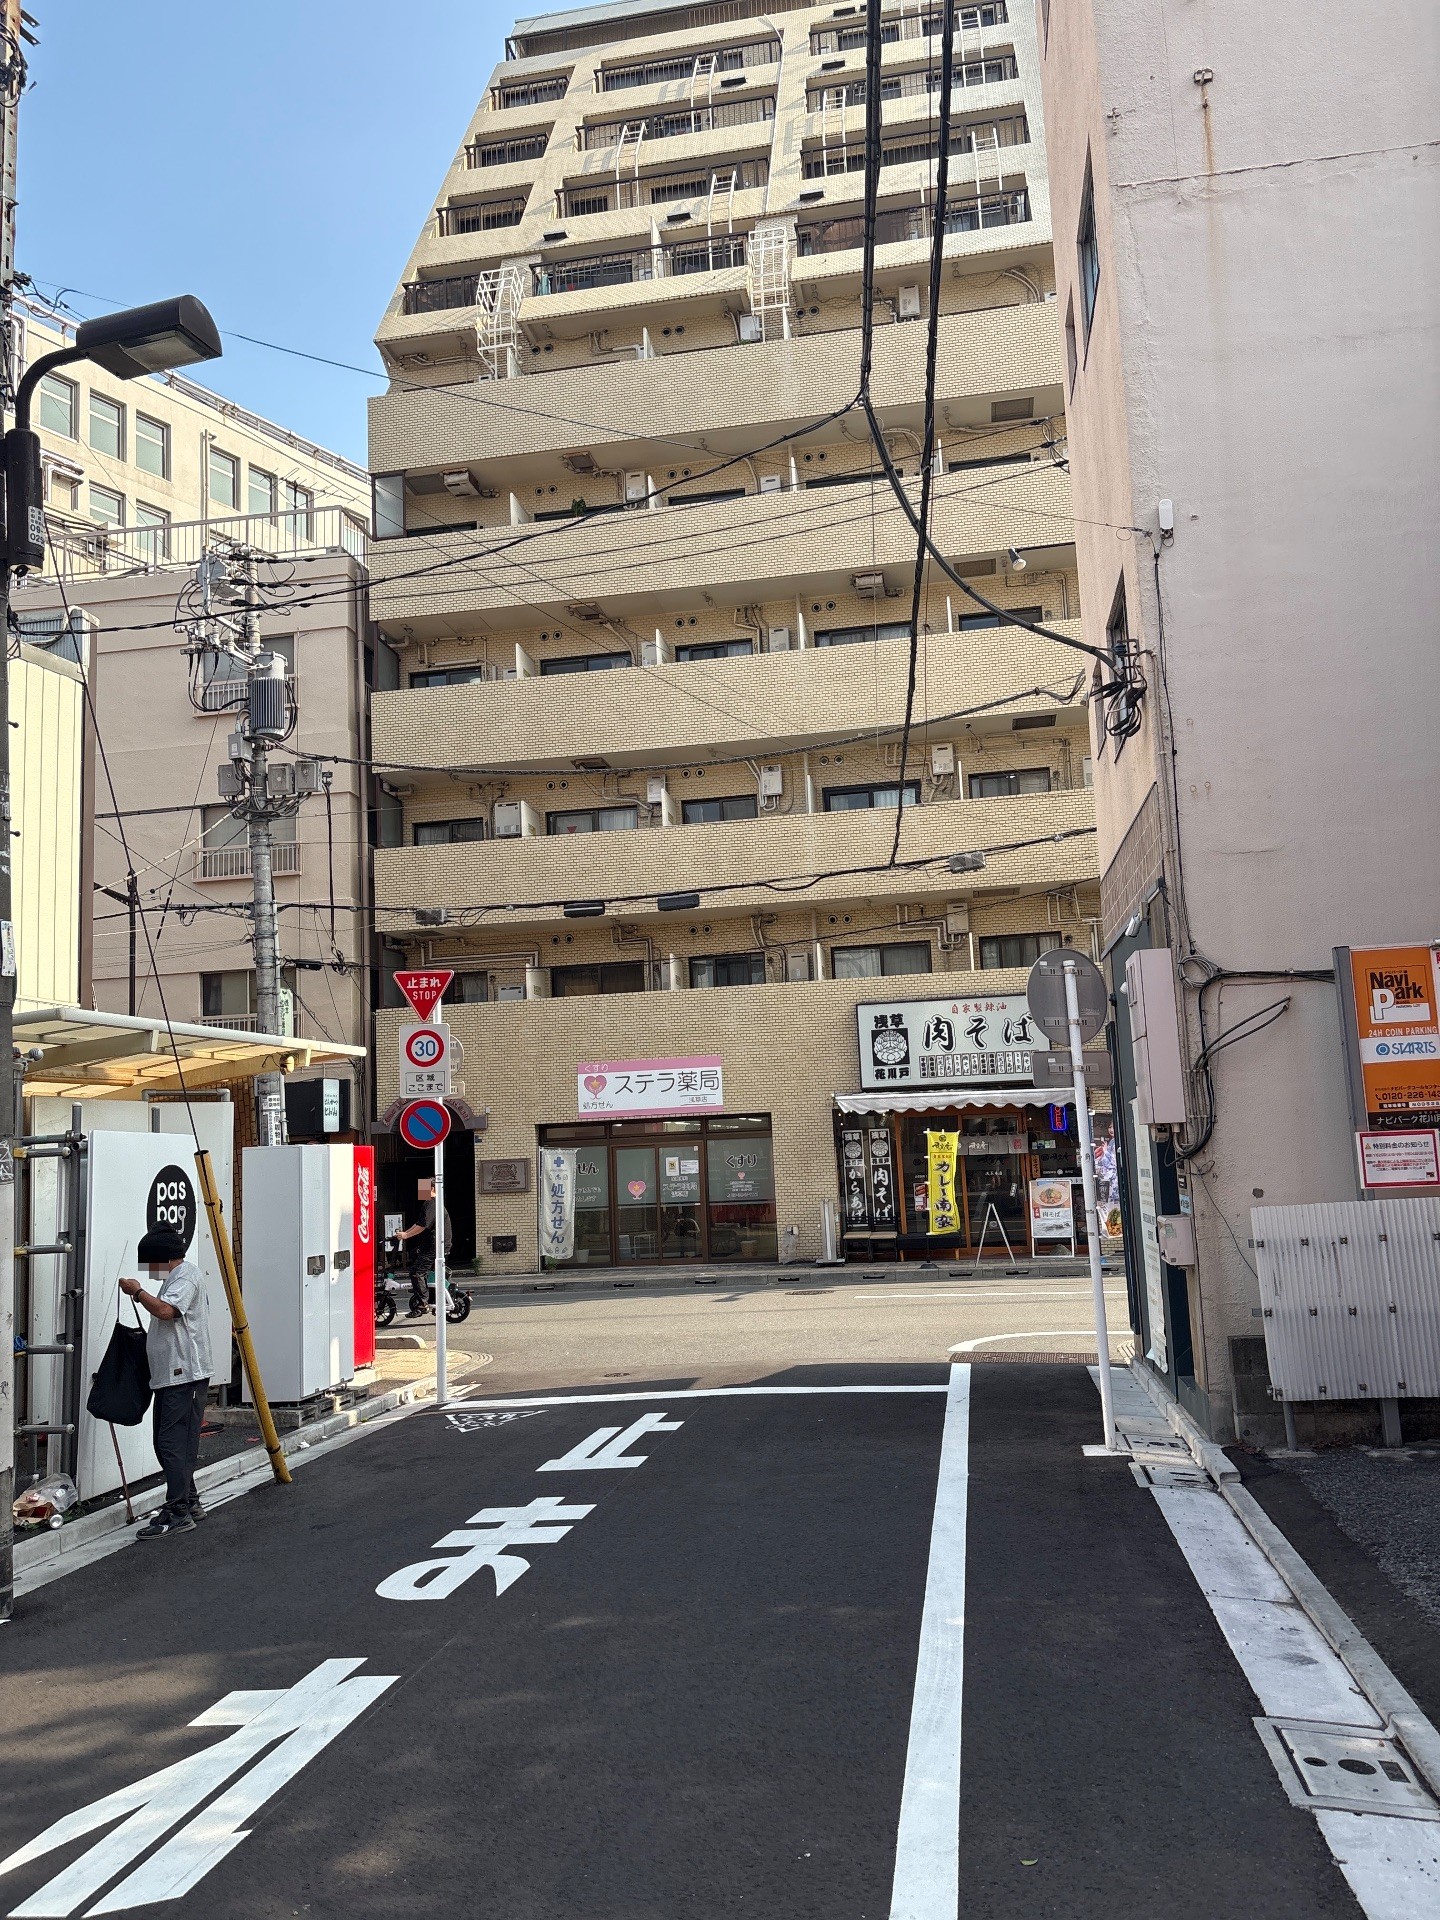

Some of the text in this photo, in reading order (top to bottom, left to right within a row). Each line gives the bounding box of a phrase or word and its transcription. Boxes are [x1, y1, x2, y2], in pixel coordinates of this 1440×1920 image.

[407, 976, 442, 989] 止まれ
[1370, 970, 1409, 989] Navi
[412, 990, 437, 1001] STOP
[1372, 982, 1424, 1020] Park
[874, 1014, 904, 1028] 浅草
[923, 1015, 1034, 1053] 肉そば
[1369, 1026, 1438, 1037] 24H COIN PARKING
[414, 1040, 436, 1057] 30
[584, 1063, 609, 1072] くすり
[874, 1067, 910, 1080] 花川戸
[415, 1073, 436, 1082] 区域
[615, 1070, 719, 1095] ステラ薬局
[408, 1083, 443, 1092] ここまで
[583, 1101, 614, 1110] 処方せん
[1373, 1141, 1430, 1150] 特別料金のお知らせ
[726, 1153, 758, 1169] くすり
[156, 1181, 187, 1206] pas
[550, 1182, 565, 1244] 処方せん
